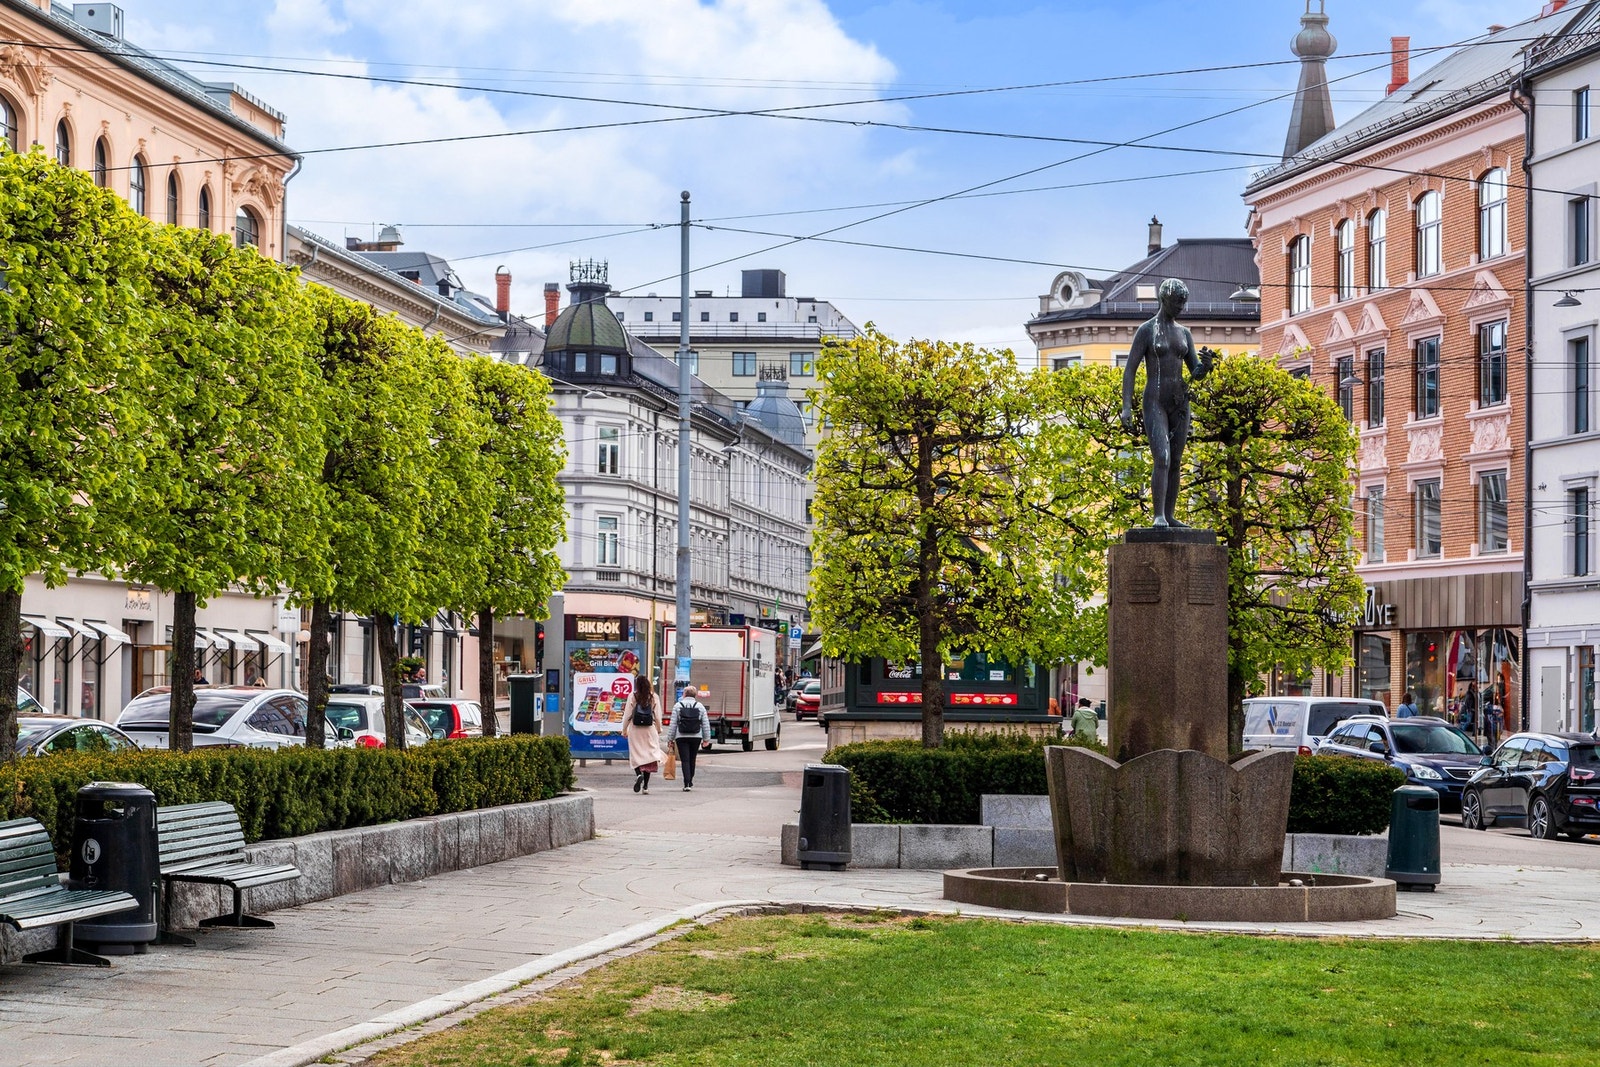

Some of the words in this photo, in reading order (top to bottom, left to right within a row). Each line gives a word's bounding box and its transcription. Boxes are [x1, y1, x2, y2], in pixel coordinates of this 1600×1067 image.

[1365, 586, 1392, 626] ØYE
[577, 621, 597, 633] BIK
[597, 621, 620, 634] BOK
[792, 630, 799, 638] P
[578, 675, 595, 683] GRILL
[613, 684, 620, 695] 3
[622, 684, 630, 695] 2
